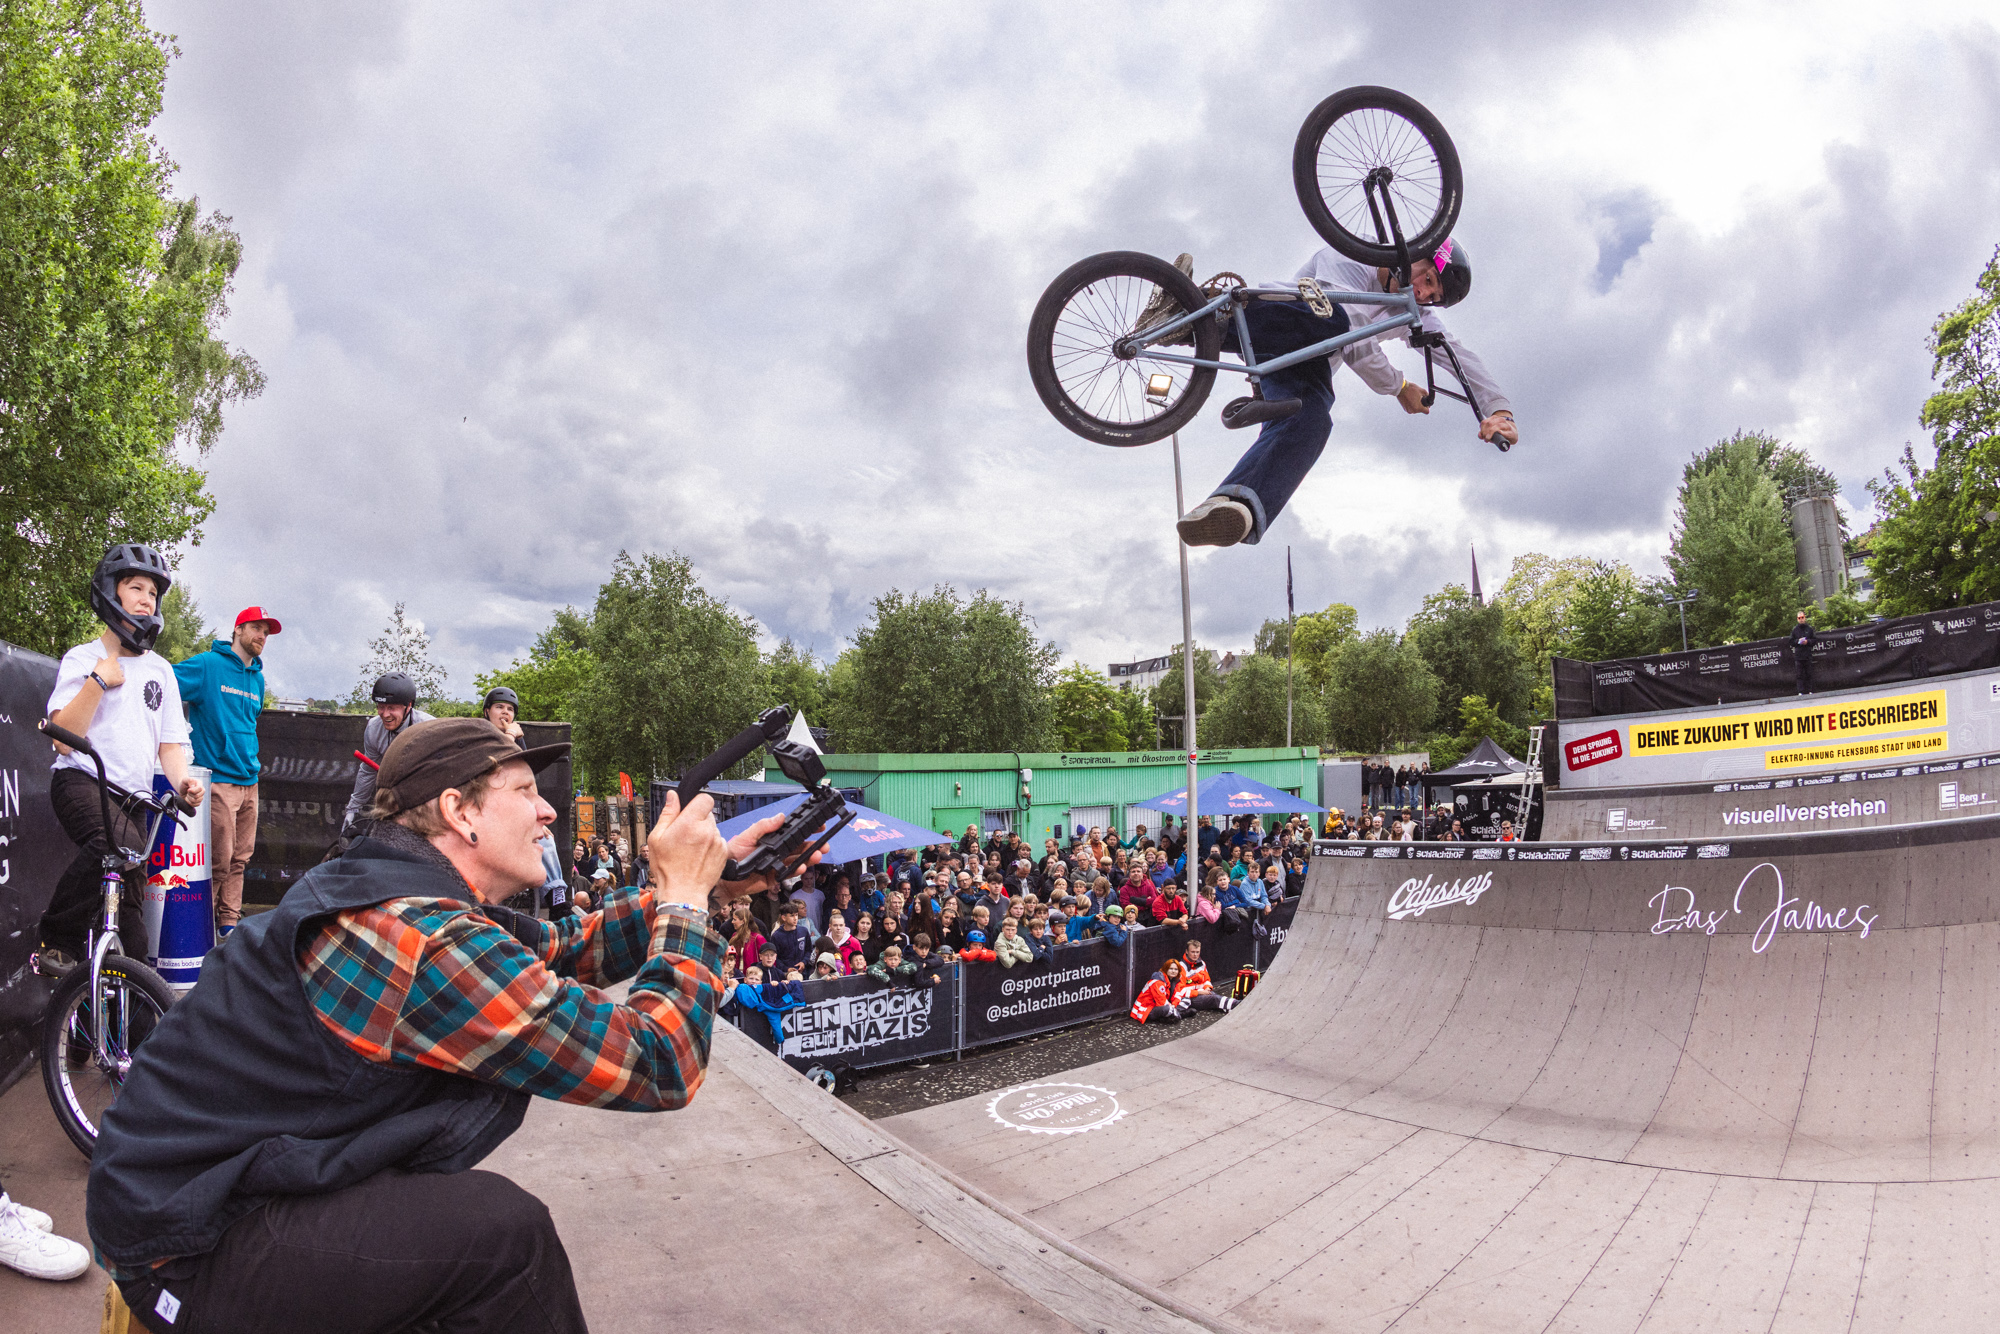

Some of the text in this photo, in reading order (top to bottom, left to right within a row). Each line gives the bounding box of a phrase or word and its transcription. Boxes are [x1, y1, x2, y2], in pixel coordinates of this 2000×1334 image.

[1947, 617, 1976, 629] NAH.SH
[1885, 629, 1925, 641] HOTEL HAFEN
[1888, 637, 1923, 648] FLENSBURG
[1811, 640, 1837, 651] AH.SH
[1740, 651, 1781, 662] HOTEL HAFEN
[1744, 658, 1779, 668] FLENSBURG
[1659, 660, 1690, 671] NAH.SH
[1596, 670, 1635, 680] HOTEL HAFEN
[1599, 676, 1633, 686] FLENSBURG
[1637, 699, 1938, 749] DEINE ZUKUNFT WIRD MIT E GESCHRIEBEN
[1572, 737, 1612, 755] DEIN SPRUNG
[1771, 737, 1942, 764] ELEKTRO-INNUNG FLENSBURG STADT UND LAND
[1127, 753, 1187, 764] mit Ökostrom de
[1572, 745, 1618, 765] IN DIE ZUKUNFT
[1228, 800, 1274, 809] Red Bull
[1959, 793, 1986, 803] Bergr
[1722, 798, 1886, 825] visuellverstehen
[859, 828, 905, 843] Red Bull
[170, 843, 205, 867] Bull
[174, 893, 203, 902] DRINK
[1387, 870, 1493, 920] Odyssey
[1648, 862, 1879, 953] Das James
[1001, 964, 1101, 996] @sportpiraten
[986, 984, 1112, 1022] @schlachthofbmx
[781, 990, 926, 1033] KEIN BOCK
[801, 1013, 928, 1049] auf NAZIS
[1019, 1092, 1065, 1108] BMX SHOP
[1019, 1093, 1096, 1121] Ride On
[1059, 1115, 1082, 1124] 2011
